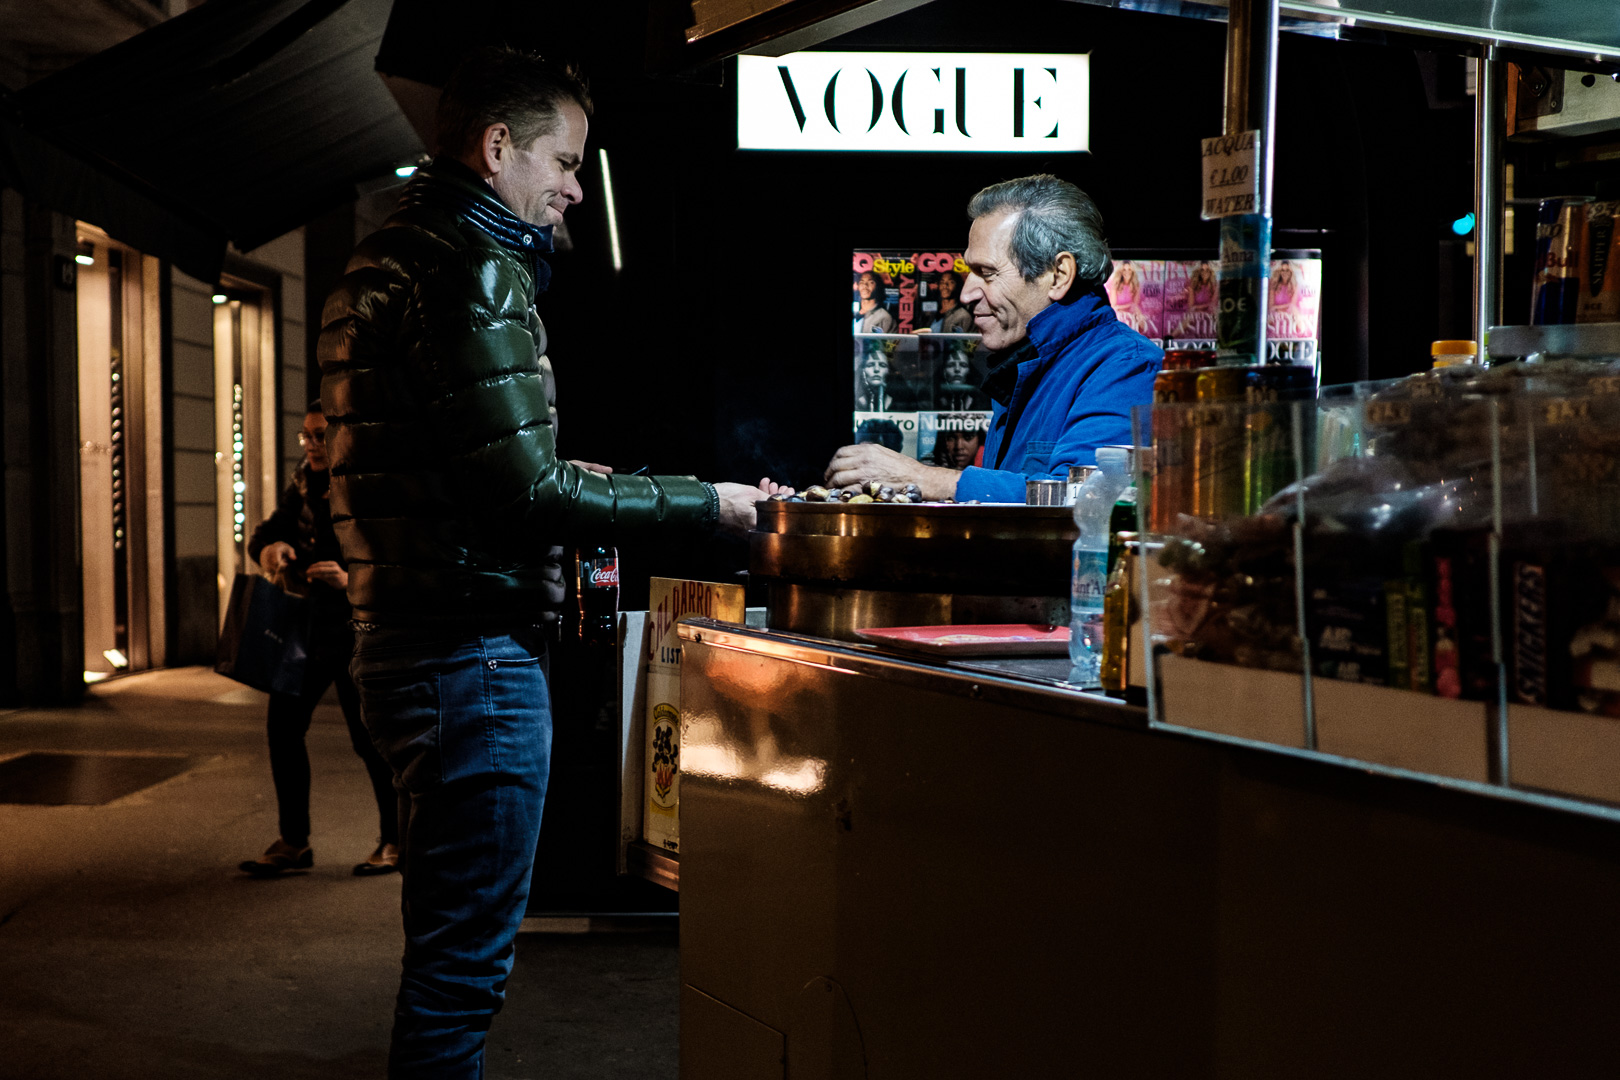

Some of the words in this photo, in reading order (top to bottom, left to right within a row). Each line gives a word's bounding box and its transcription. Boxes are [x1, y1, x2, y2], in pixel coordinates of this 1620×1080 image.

[776, 65, 1059, 139] VOGUE
[1203, 133, 1254, 156] ACQUA
[1206, 193, 1254, 214] WATER
[873, 258, 915, 278] Style
[917, 252, 955, 274] GQ
